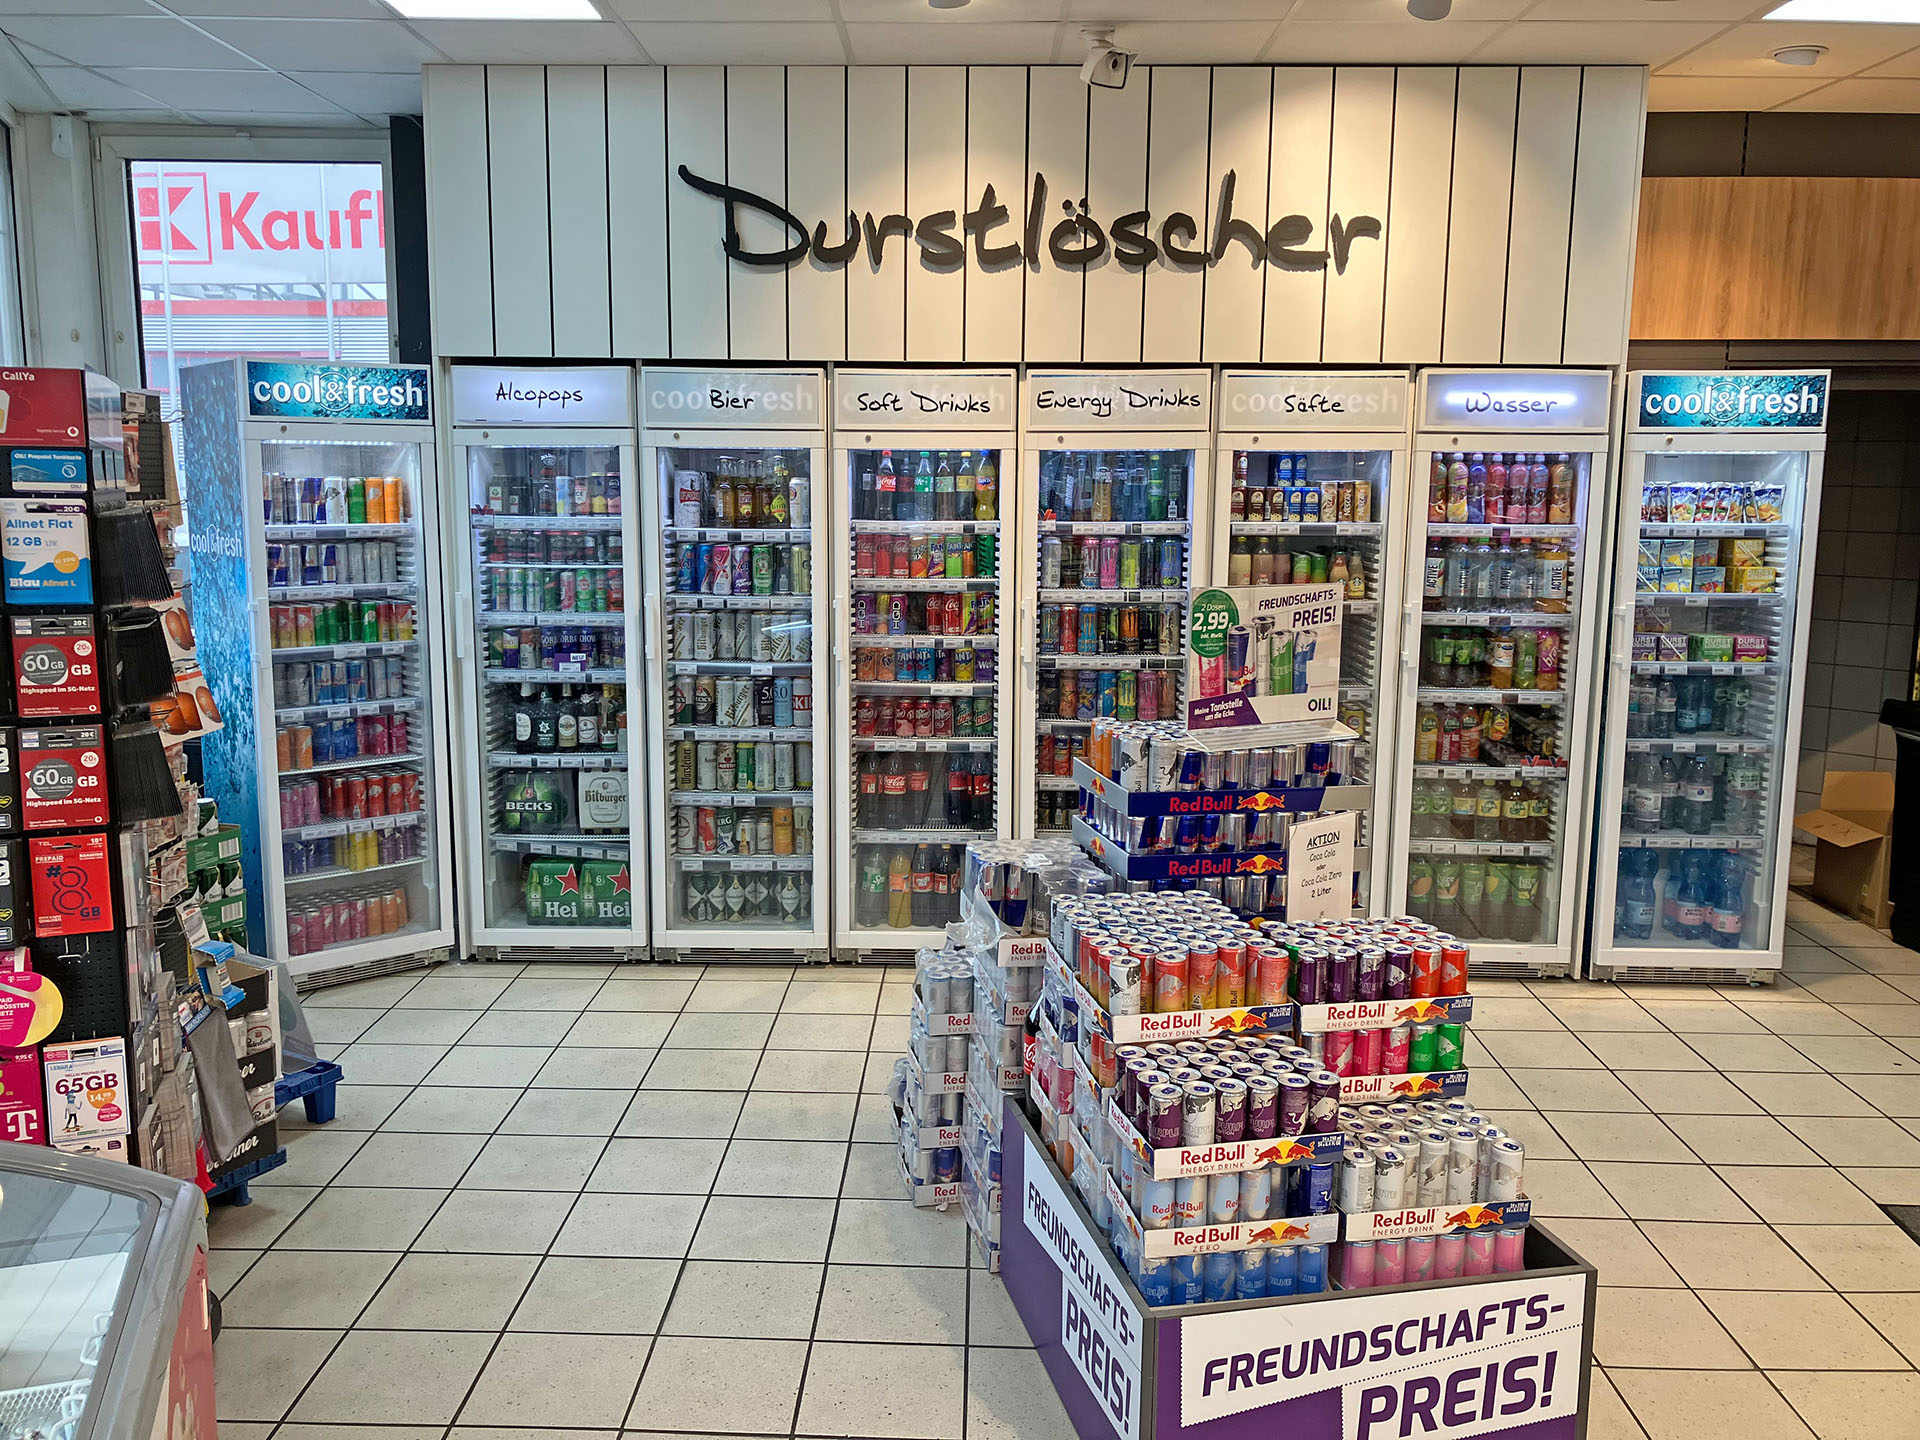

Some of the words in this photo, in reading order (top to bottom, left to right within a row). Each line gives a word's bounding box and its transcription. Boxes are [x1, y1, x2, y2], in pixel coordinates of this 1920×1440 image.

[678, 165, 1382, 273] Durstlöscher
[2, 371, 35, 382] CallYa
[253, 373, 423, 408] cool&fresh
[495, 381, 584, 409] Alcopops
[708, 389, 754, 409] Bier
[857, 392, 904, 413] Soft
[910, 390, 991, 413] Drinks
[1036, 390, 1112, 417] Energy
[1119, 386, 1201, 408] Drinks
[1284, 394, 1345, 413] Säfte
[1465, 391, 1558, 415] Wasser
[1645, 382, 1819, 418] cool&fresh
[6, 519, 44, 528] Allnet
[48, 518, 73, 528] Flat
[6, 537, 20, 546] 12
[23, 537, 42, 547] GB
[191, 527, 243, 559] cool&fresh
[9, 578, 40, 587] Blau
[1258, 589, 1337, 610] FREUNDSCHAFTS-
[1192, 612, 1229, 632] 2,99
[1292, 606, 1336, 628] PREIS!
[23, 654, 50, 671] 60
[50, 662, 64, 670] GB
[70, 664, 92, 676] GB
[1210, 698, 1243, 712] Tankstelle
[1308, 698, 1332, 712] OIL!
[32, 770, 59, 785] 60
[78, 776, 98, 787] GB
[505, 800, 553, 811] BECK'S
[1170, 796, 1200, 812] Red
[1202, 795, 1232, 811] Bull
[1306, 830, 1340, 848] AKTION
[1310, 852, 1322, 862] Coca
[1324, 849, 1336, 858] Cola
[1168, 859, 1200, 876] Red
[1202, 858, 1231, 874] Bull
[1301, 878, 1314, 887] Coca
[1316, 875, 1328, 884] Cola
[1328, 872, 1342, 880] Zero
[1312, 890, 1316, 898] 2
[1317, 888, 1332, 896] Liter
[80, 906, 100, 918] GB
[545, 902, 578, 918] Hei
[1011, 944, 1033, 954] Red
[1035, 943, 1047, 954] Bu
[1328, 1004, 1358, 1020] Red
[1358, 1002, 1386, 1018] Bull
[948, 1015, 970, 1026] Red
[1140, 1015, 1170, 1031] Red
[1173, 1012, 1201, 1028] Bull
[1326, 1020, 1358, 1028] ENERGY
[1140, 1031, 1173, 1040] ENERGY
[943, 1074, 966, 1084] Red
[1004, 1070, 1024, 1080] Red
[1340, 1079, 1352, 1094] ed
[1354, 1078, 1382, 1092] Bull
[939, 1129, 960, 1140] Red
[1181, 1149, 1212, 1166] Red
[1213, 1145, 1246, 1161] Bull
[1180, 1165, 1216, 1175] ENERGY
[1217, 1162, 1244, 1171] DRINK
[934, 1186, 956, 1197] Red
[1186, 1201, 1204, 1212] Bull
[1374, 1212, 1406, 1228] Red
[1406, 1209, 1436, 1224] Bull
[1174, 1229, 1207, 1246] Red
[1208, 1226, 1240, 1242] Bull
[1372, 1228, 1406, 1236] ENERGY
[1408, 1226, 1434, 1234] DRINK
[1192, 1244, 1220, 1252] ZERO
[1028, 1180, 1136, 1347] FREUNDSCHAFTS-
[1202, 1293, 1566, 1398] FREUNDSCHAFTS-
[1066, 1288, 1132, 1435] PREIS!
[1356, 1350, 1559, 1440] PREIS!
